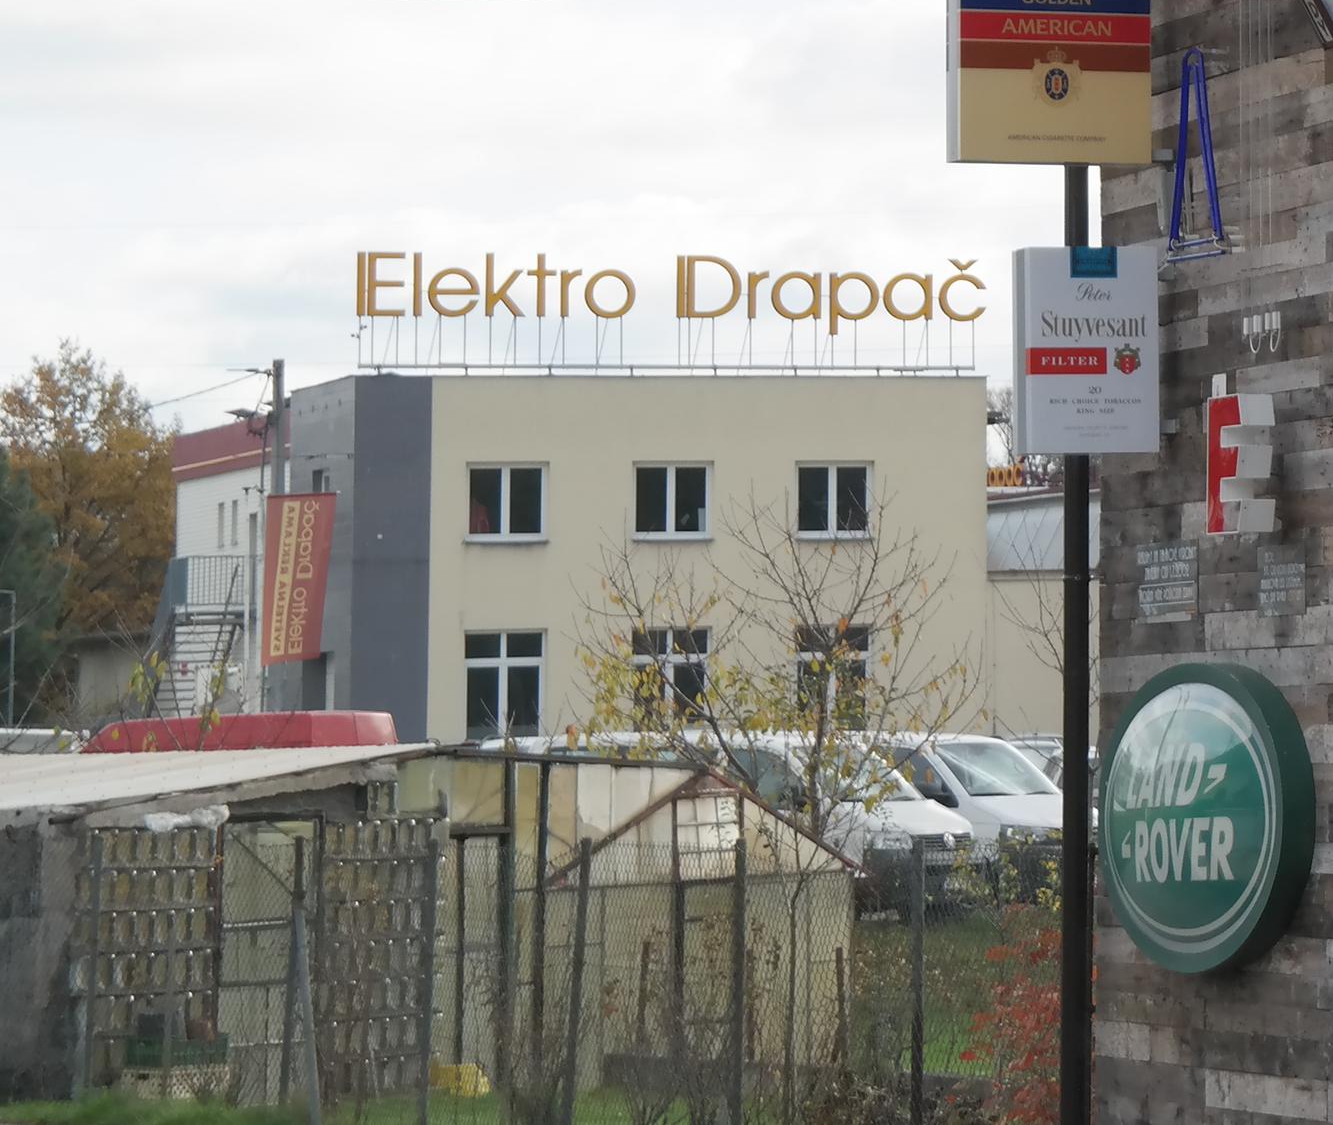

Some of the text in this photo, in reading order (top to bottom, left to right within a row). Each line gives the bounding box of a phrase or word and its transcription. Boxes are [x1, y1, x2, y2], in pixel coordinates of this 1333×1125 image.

[1002, 17, 1112, 37] AMERICAN
[1007, 134, 1041, 142] AMERICAN
[356, 252, 988, 336] Elektro Drapač
[1075, 282, 1113, 302] Peter
[1041, 311, 1148, 343] Stuyvesant
[1041, 355, 1100, 367] FILTER
[1125, 741, 1206, 811] LAND
[1134, 816, 1235, 883] ROVER
